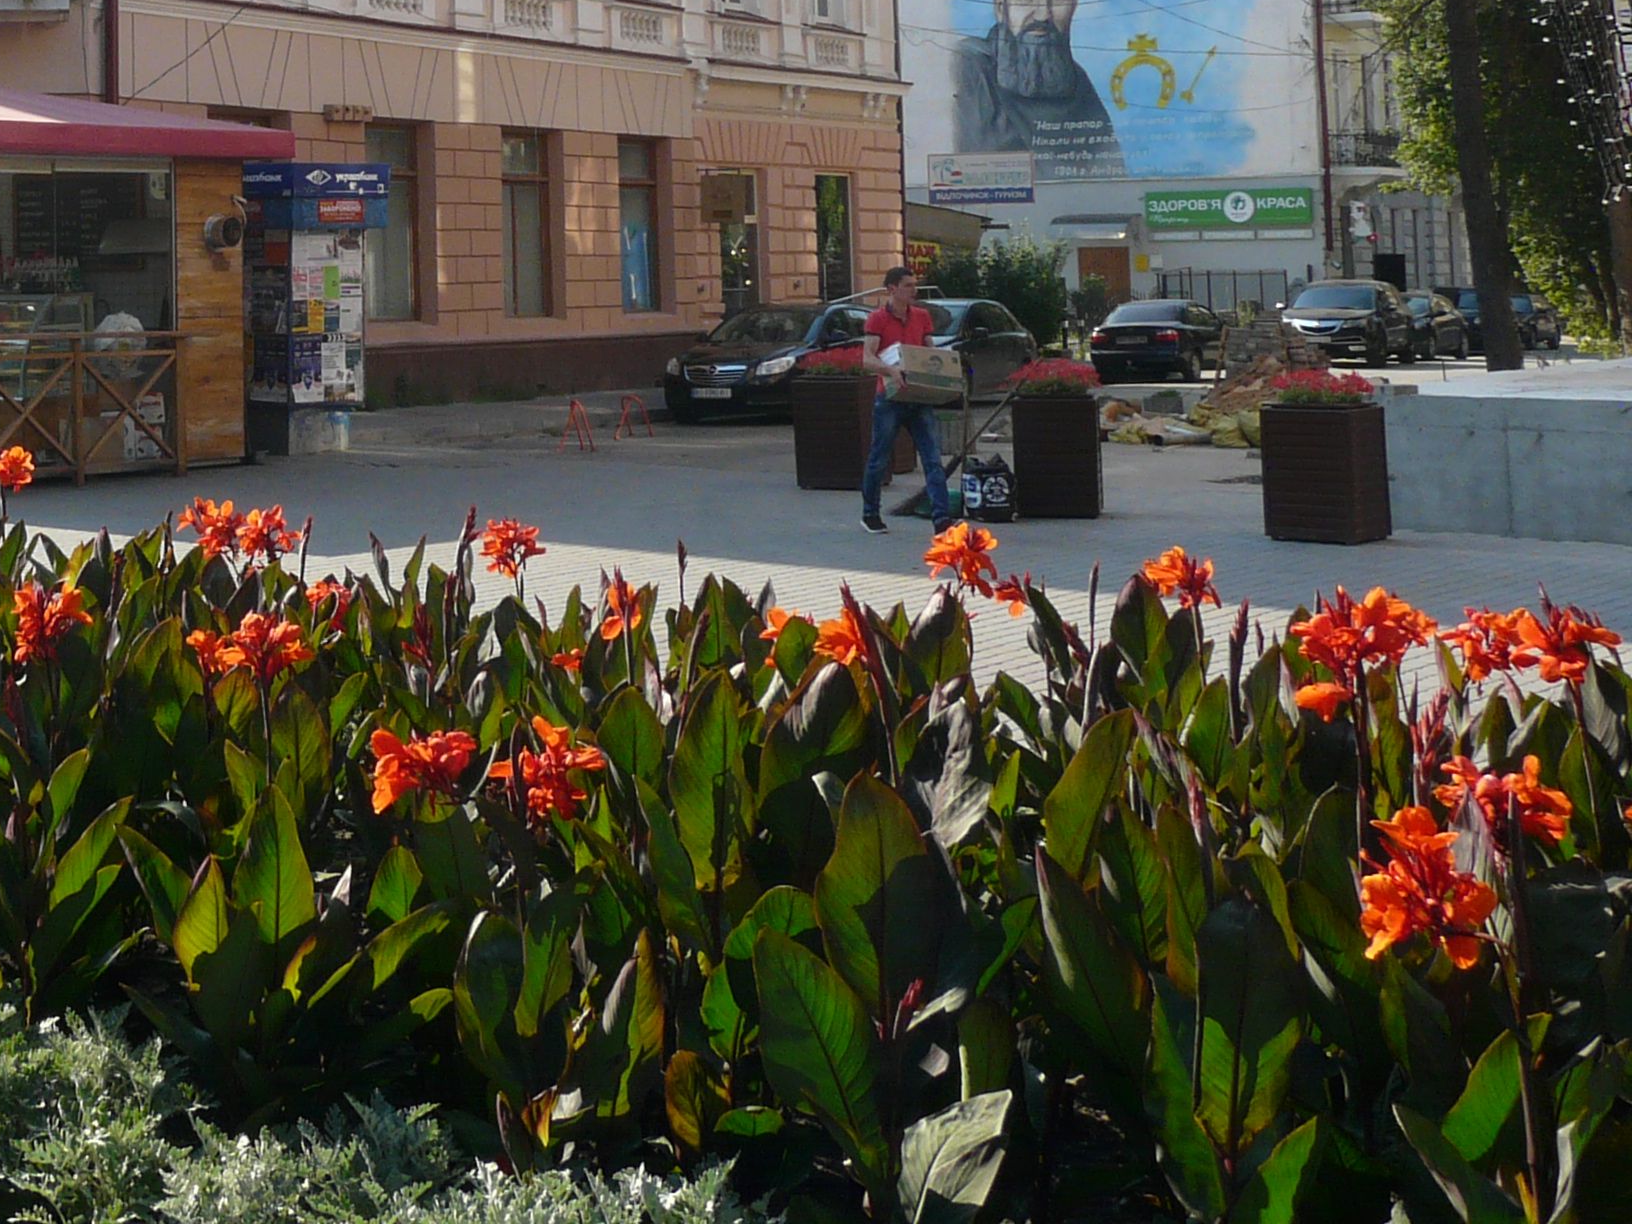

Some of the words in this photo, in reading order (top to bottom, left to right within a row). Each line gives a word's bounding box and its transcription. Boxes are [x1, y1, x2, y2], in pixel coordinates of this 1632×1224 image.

[1064, 119, 1103, 131] прапор
[1032, 136, 1070, 147] Ніколи
[1148, 199, 1222, 212] ЗДОРОВ'Я
[1256, 196, 1307, 209] КРАСА
